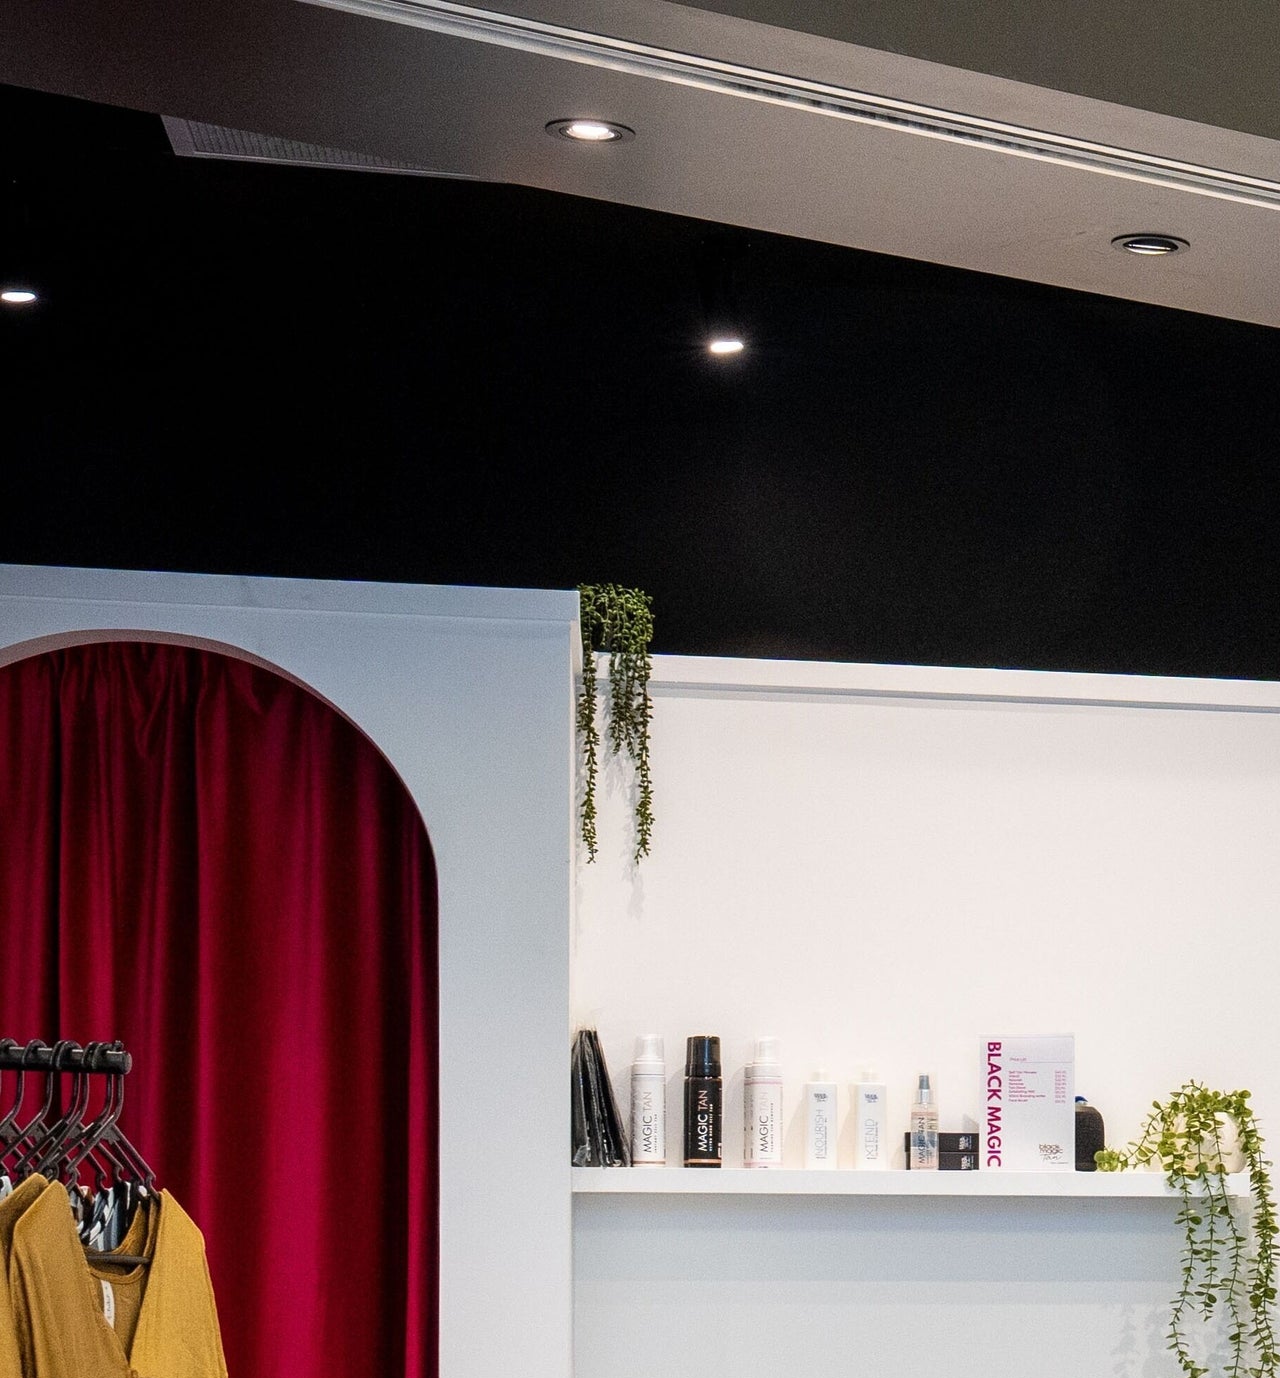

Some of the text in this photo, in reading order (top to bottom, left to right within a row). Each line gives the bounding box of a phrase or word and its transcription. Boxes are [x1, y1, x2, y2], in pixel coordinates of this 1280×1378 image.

[642, 1091, 653, 1153] MAGIC TAN
[697, 1090, 708, 1152] MAGIC TAN
[758, 1115, 769, 1153] MAGIC
[986, 1041, 1002, 1167] BLACK MAGIC
